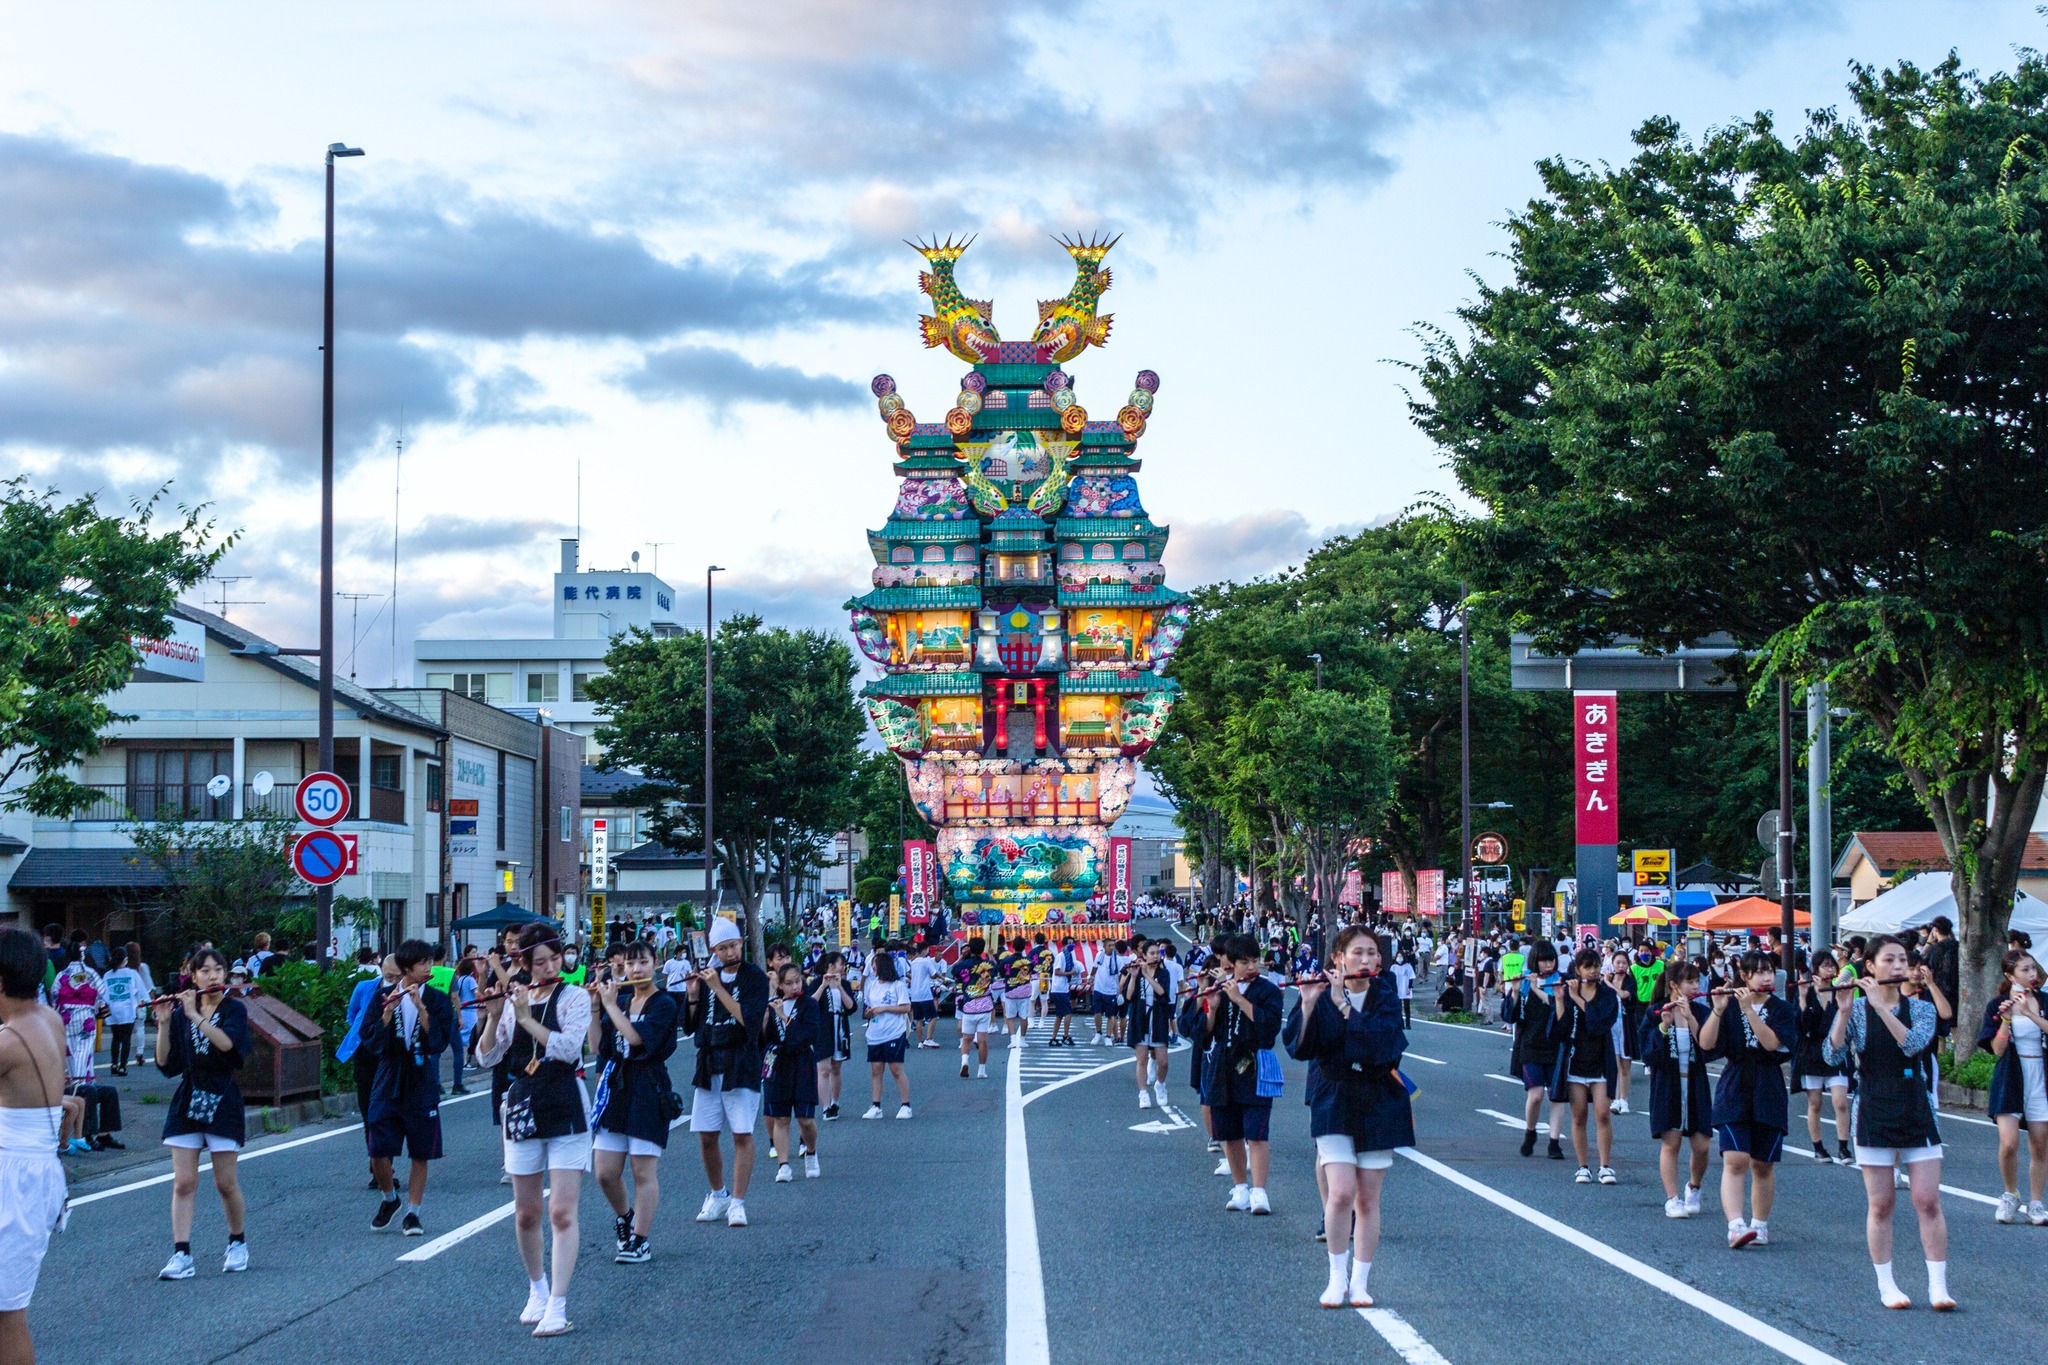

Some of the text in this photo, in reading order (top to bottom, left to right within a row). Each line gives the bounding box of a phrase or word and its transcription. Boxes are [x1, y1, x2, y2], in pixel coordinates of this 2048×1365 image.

[564, 586, 641, 600] 能代病院
[1585, 703, 1608, 811] あきぎん
[307, 787, 339, 812] 50
[593, 897, 603, 945] 電気工事店
